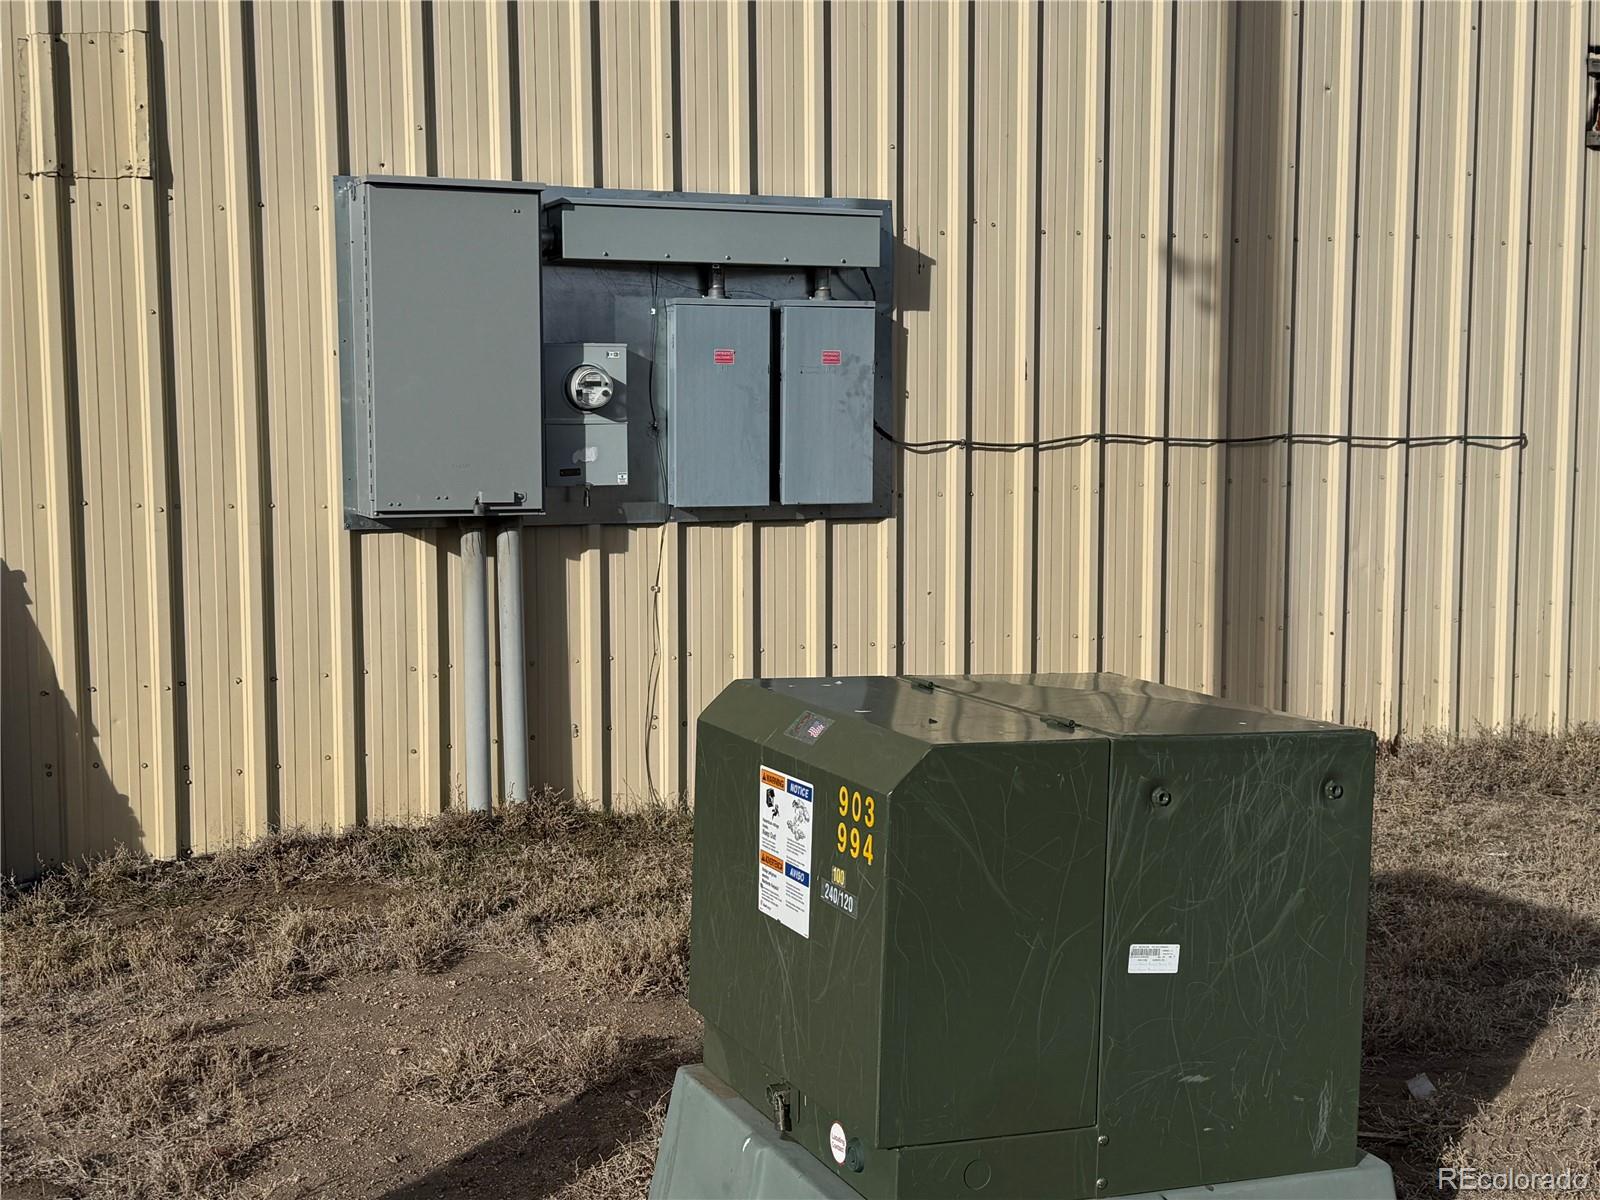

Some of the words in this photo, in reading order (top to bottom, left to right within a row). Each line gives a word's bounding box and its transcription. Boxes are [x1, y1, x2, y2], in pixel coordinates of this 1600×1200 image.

[790, 783, 810, 799] NOTICE
[839, 785, 876, 828] 903
[837, 822, 874, 866] 994
[789, 867, 805, 882] AVISO
[833, 866, 845, 885] 100
[824, 883, 854, 913] 240/120
